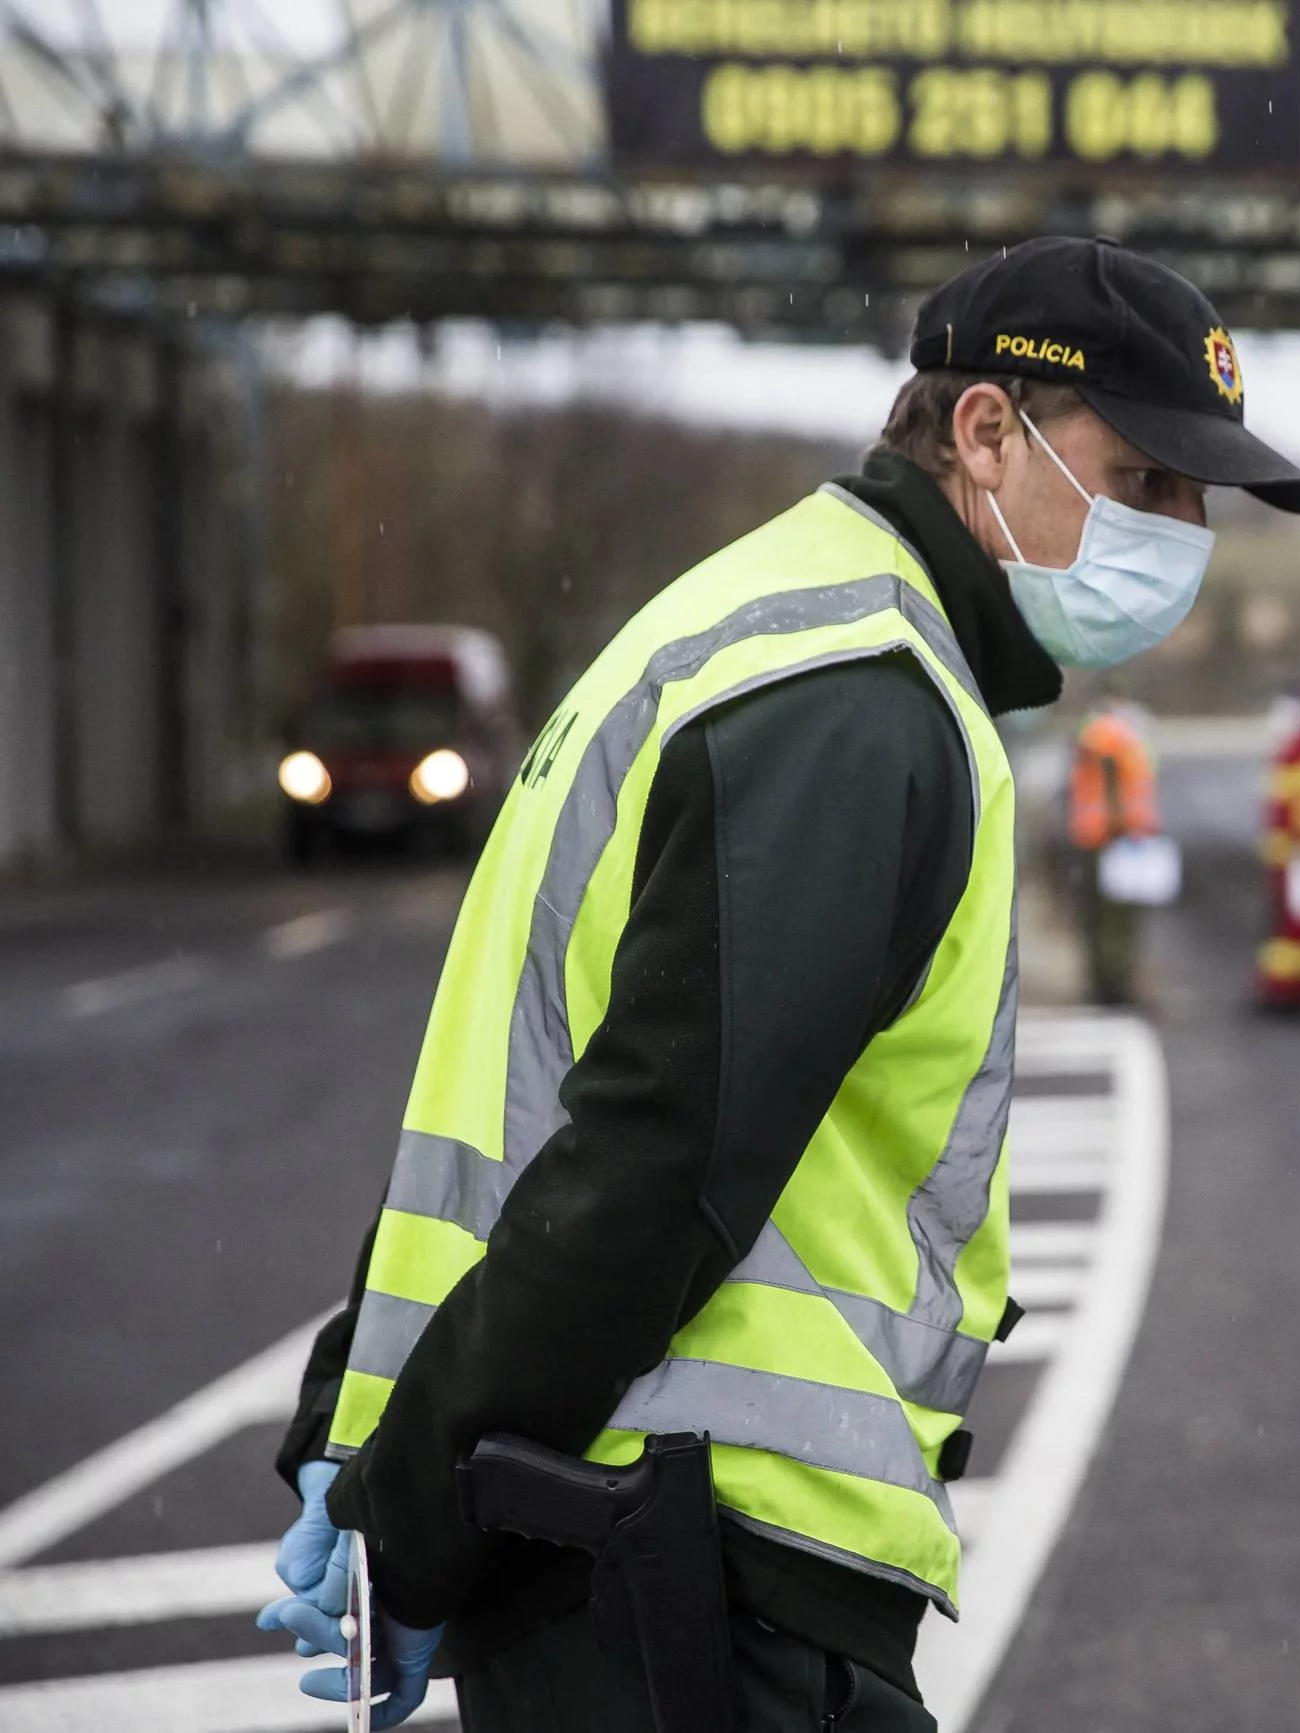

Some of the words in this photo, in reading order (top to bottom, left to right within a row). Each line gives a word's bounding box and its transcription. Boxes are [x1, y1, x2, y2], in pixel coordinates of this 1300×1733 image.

[705, 65, 898, 154] 0905
[912, 67, 1050, 157] 251
[1066, 71, 1216, 159] 044
[995, 334, 1085, 371] POLÍCIA
